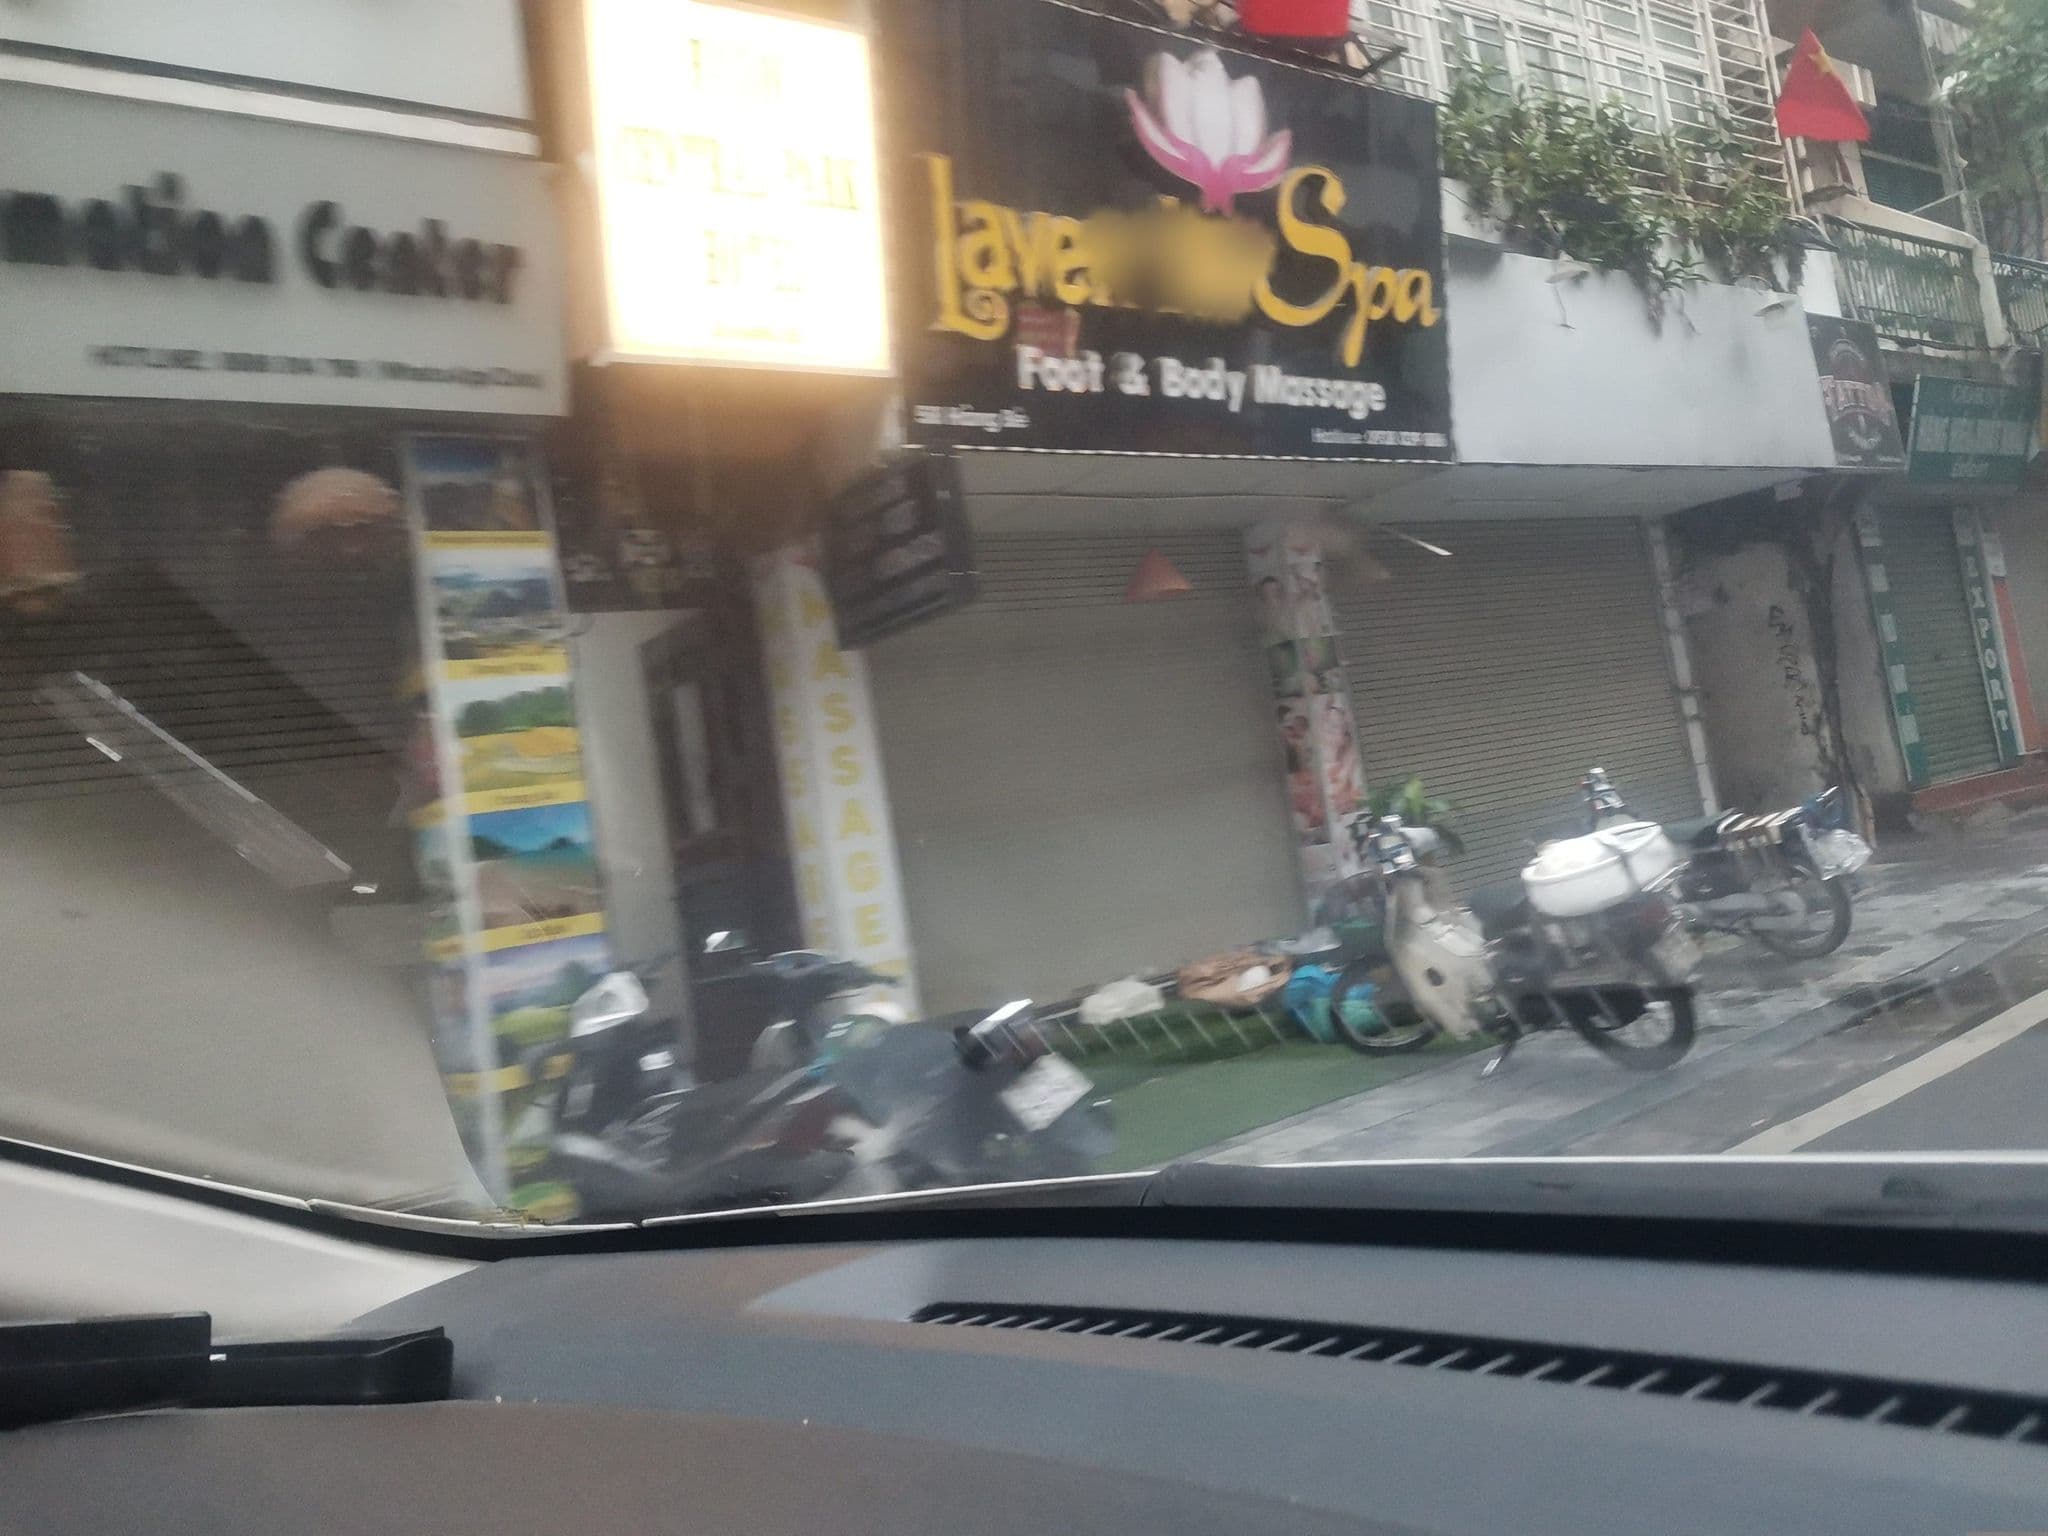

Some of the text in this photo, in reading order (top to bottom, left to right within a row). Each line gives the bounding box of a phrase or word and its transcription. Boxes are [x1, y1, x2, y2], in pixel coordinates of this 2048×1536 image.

[297, 199, 523, 306] Center
[915, 152, 1440, 367] Lave Spa
[1018, 344, 1387, 419] Foot & Body Massage
